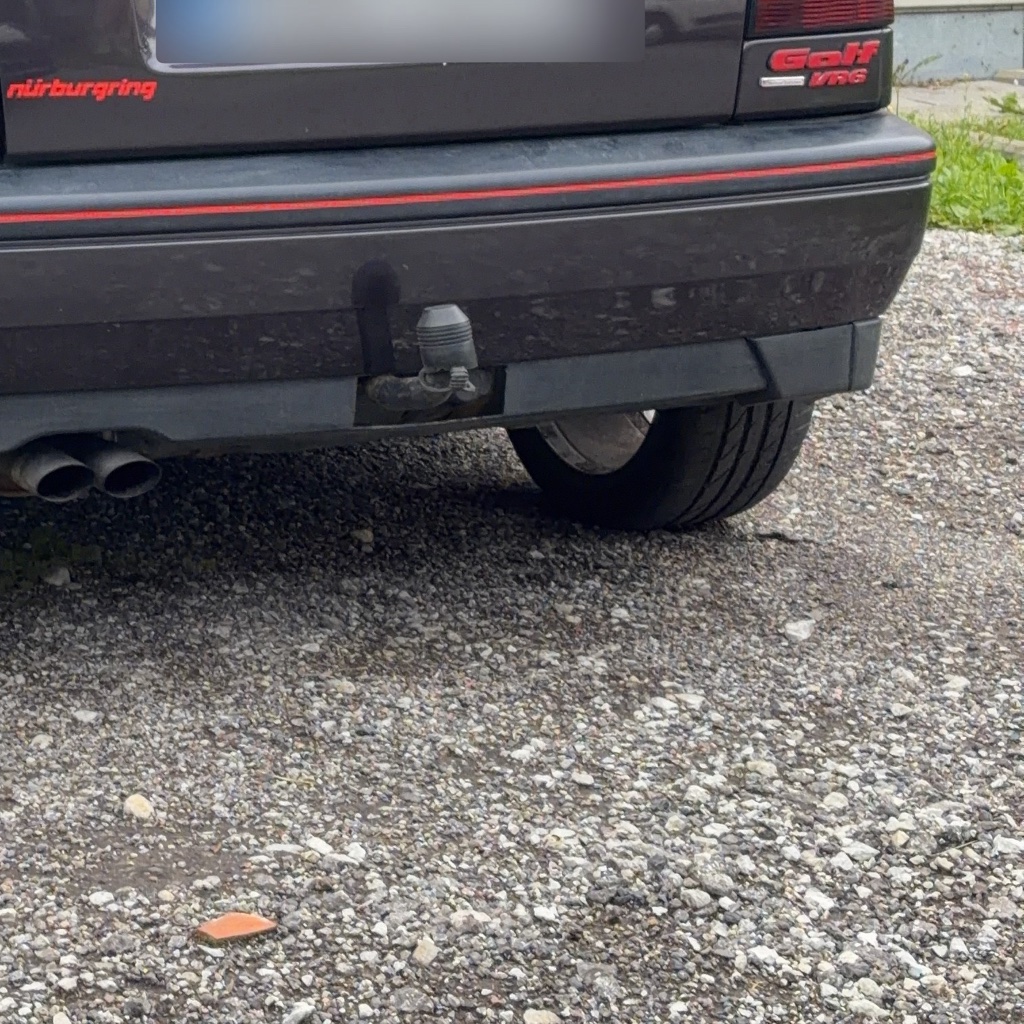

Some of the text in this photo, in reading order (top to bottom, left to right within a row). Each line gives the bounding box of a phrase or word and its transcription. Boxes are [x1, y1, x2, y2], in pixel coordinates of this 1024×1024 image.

[769, 40, 881, 71] Golf
[6, 78, 158, 102] nürburgring
[808, 68, 868, 88] VR6
